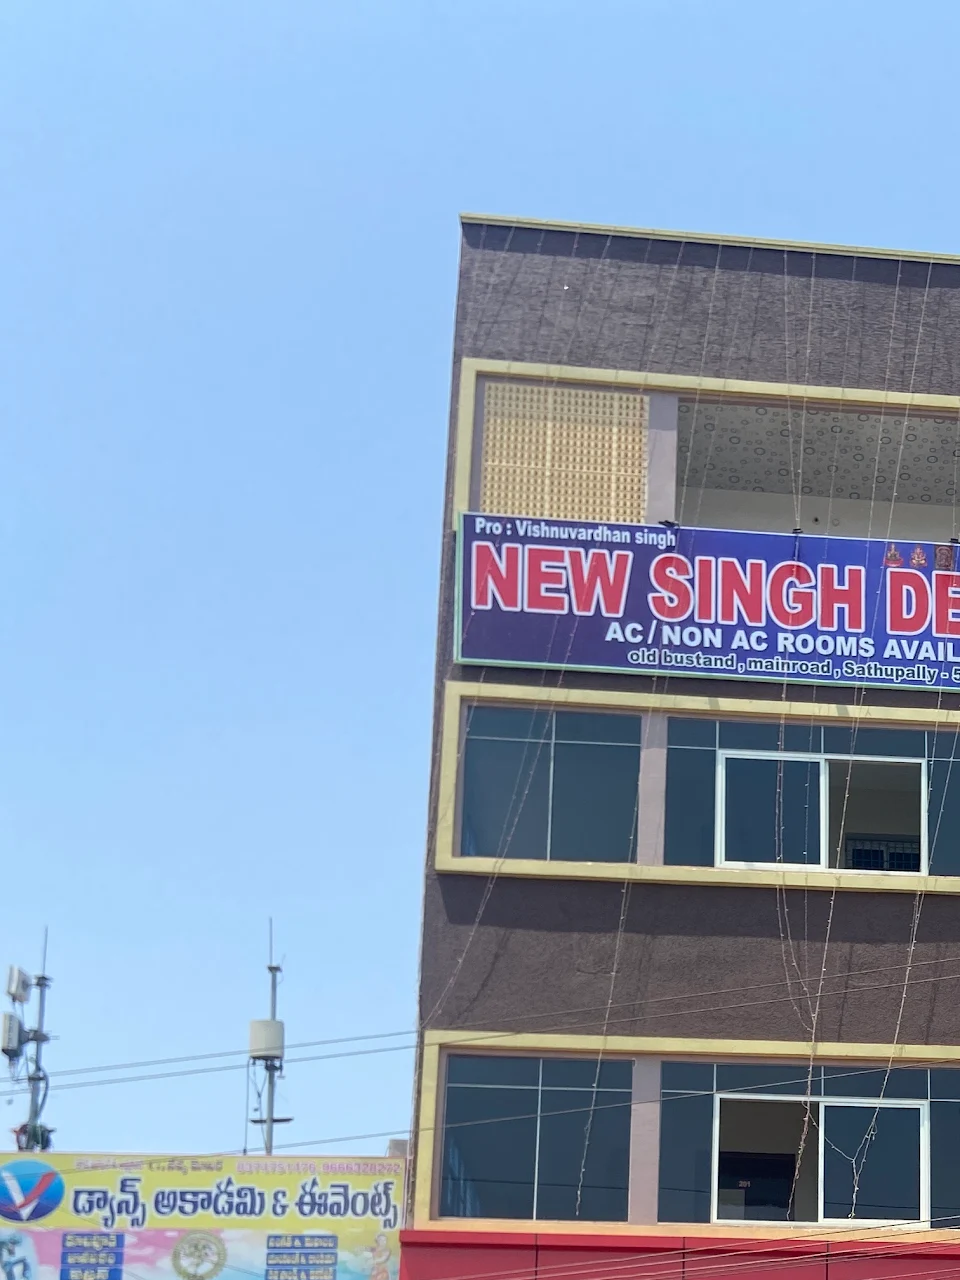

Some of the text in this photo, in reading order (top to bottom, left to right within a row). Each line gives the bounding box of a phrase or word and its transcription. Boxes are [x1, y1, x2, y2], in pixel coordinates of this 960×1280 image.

[516, 519, 631, 545] Vishnuvardhan
[634, 530, 676, 549] singh
[470, 541, 633, 617] NEW
[647, 552, 867, 633] SINGH
[731, 628, 768, 652] AC
[777, 633, 875, 659] ROOMS
[627, 647, 657, 665] old
[843, 661, 937, 683] Sathupally
